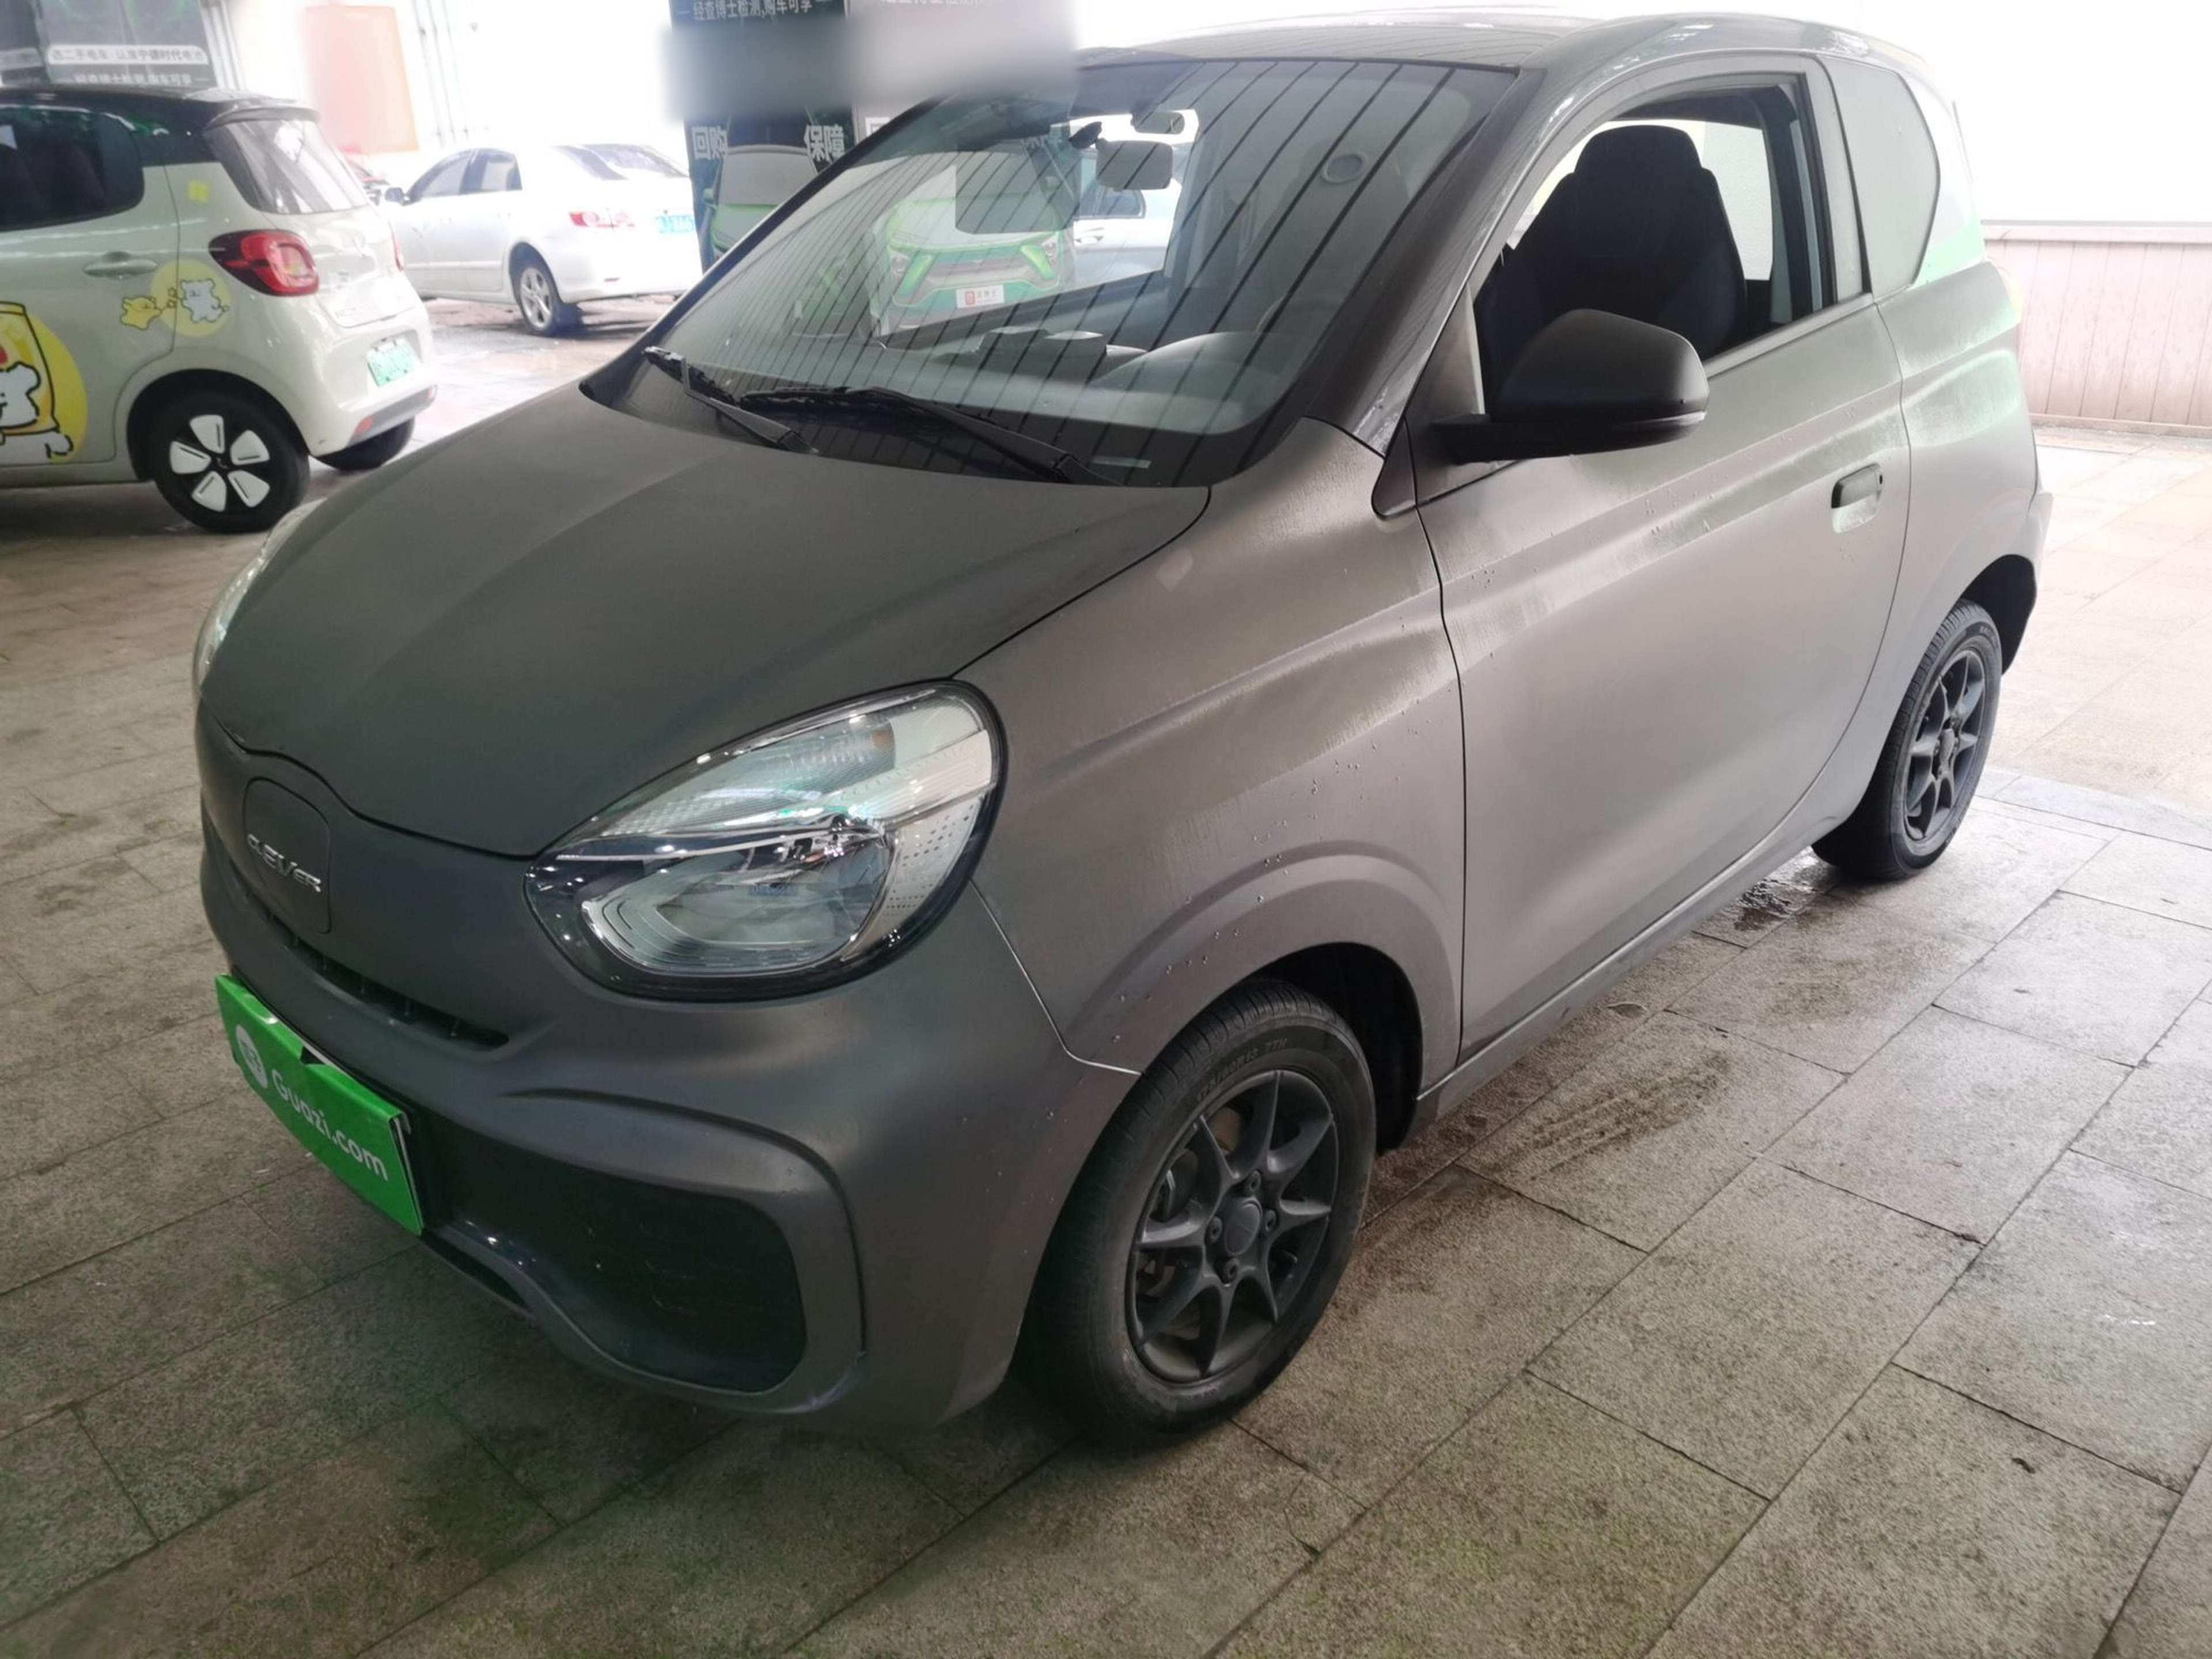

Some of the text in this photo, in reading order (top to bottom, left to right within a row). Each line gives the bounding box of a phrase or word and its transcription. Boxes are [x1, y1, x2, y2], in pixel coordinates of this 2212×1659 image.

[691, 125, 728, 161] 回购
[804, 123, 846, 165] 保障
[271, 1069, 388, 1181] Guazi.com
